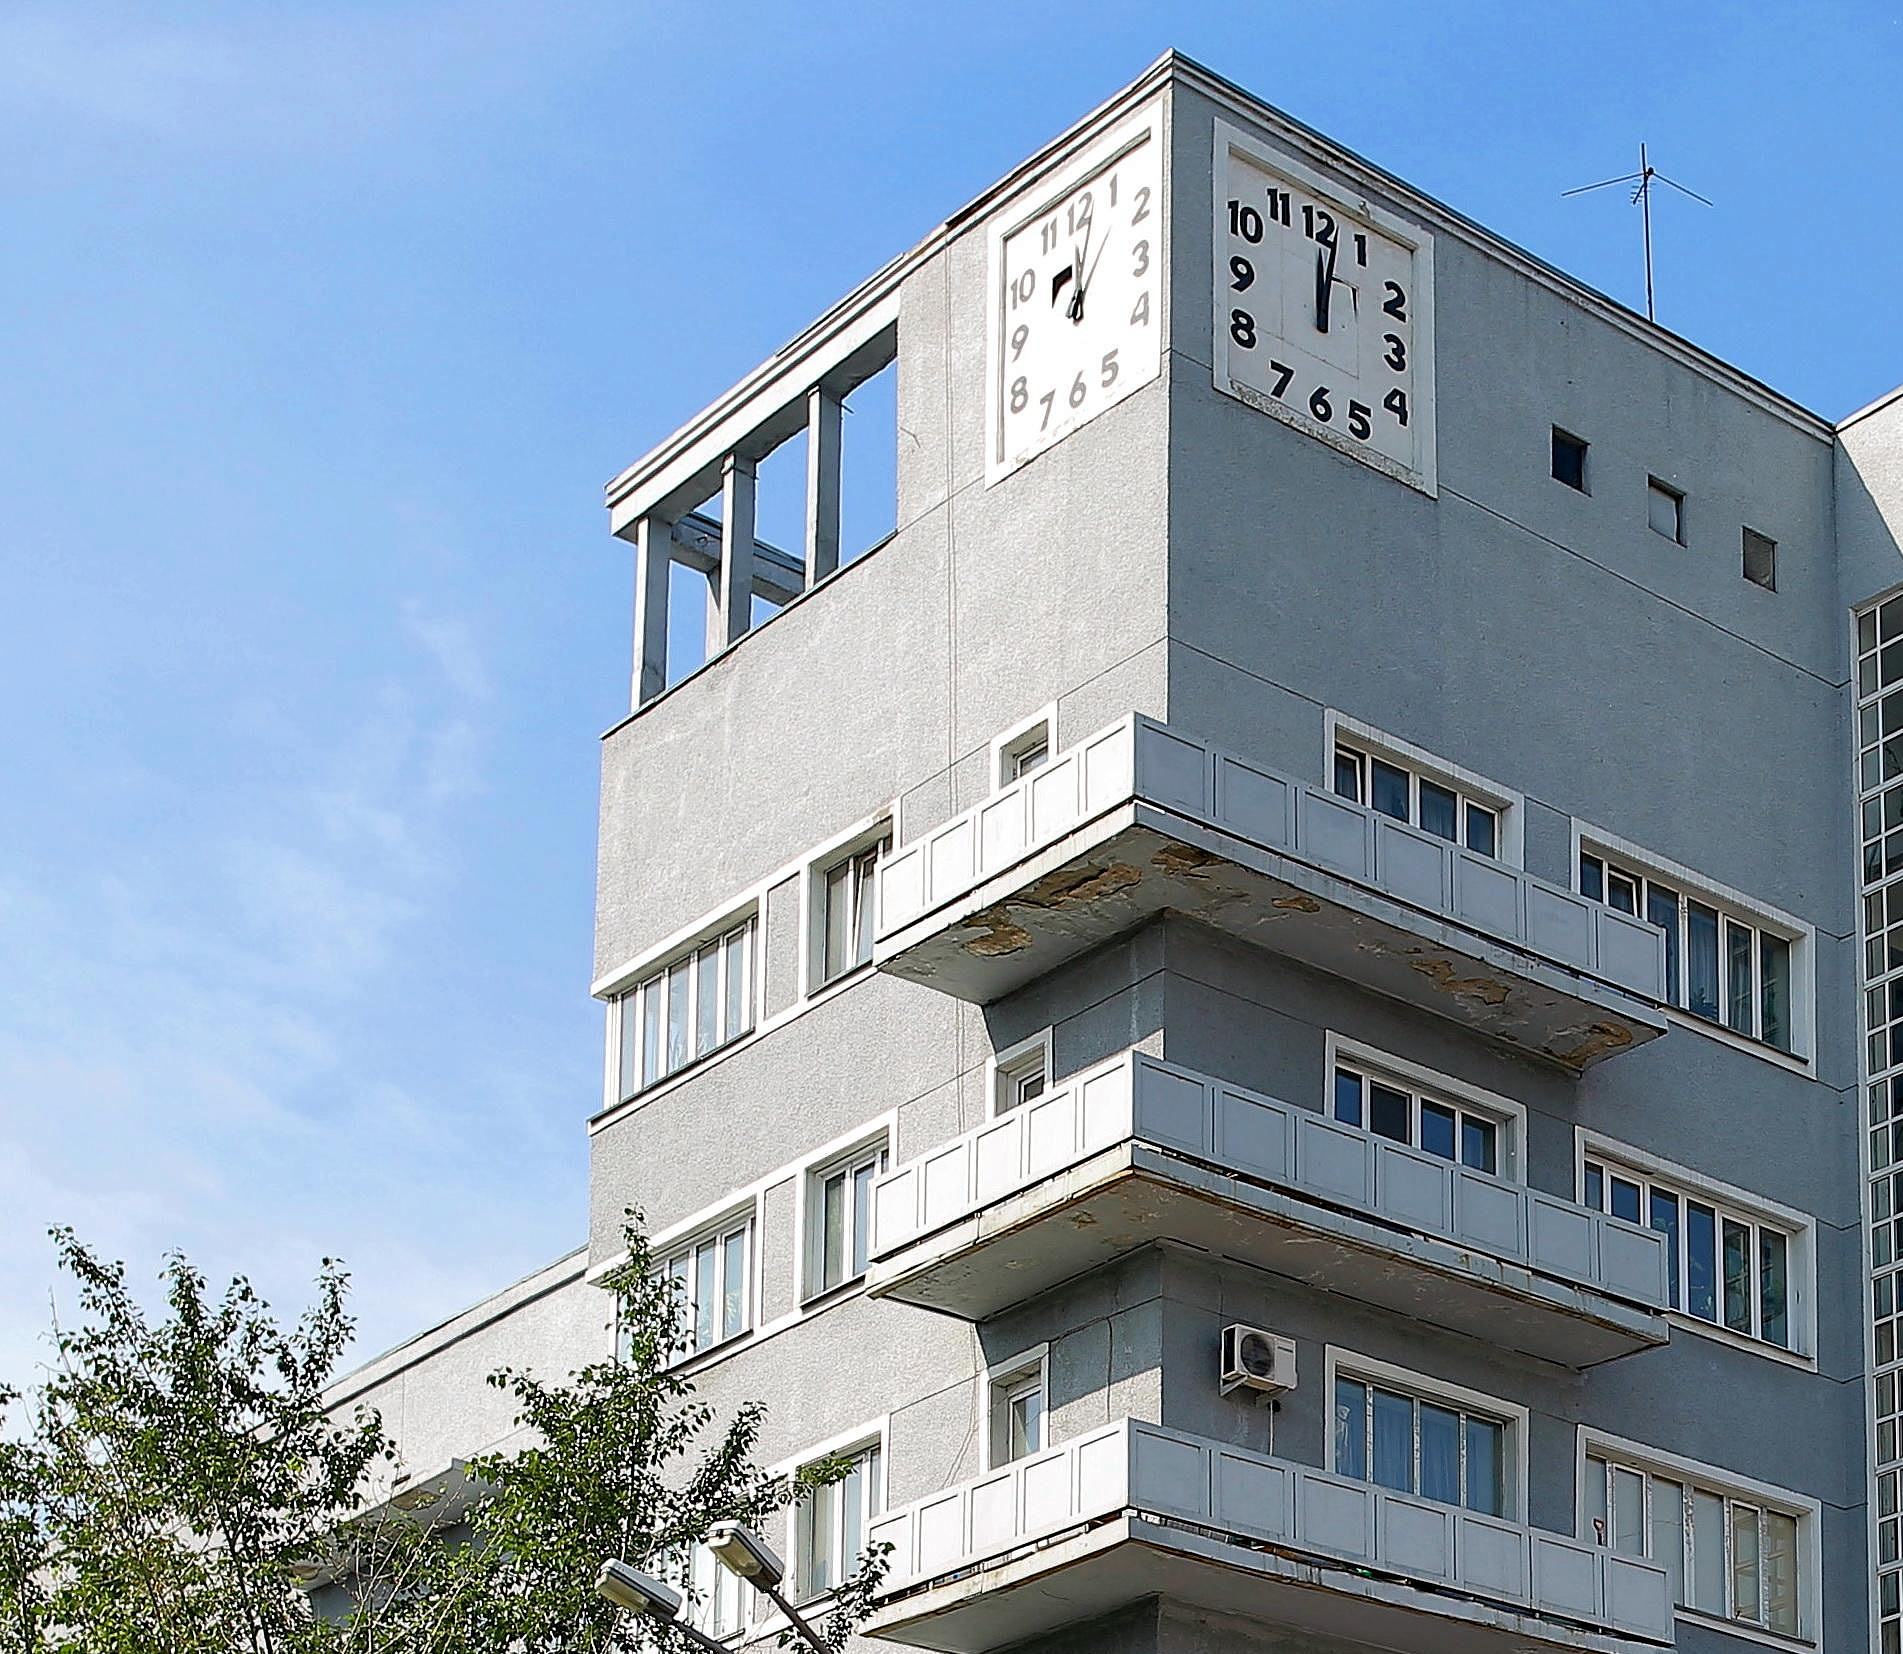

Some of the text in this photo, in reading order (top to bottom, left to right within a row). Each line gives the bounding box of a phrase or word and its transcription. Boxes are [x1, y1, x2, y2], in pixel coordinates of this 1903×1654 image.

[1110, 173, 1118, 208] 1
[1132, 186, 1150, 227] 2
[1267, 188, 1291, 227] 11
[1067, 191, 1092, 236] 12
[1228, 200, 1263, 243] 10
[1302, 205, 1336, 249] 12
[1041, 216, 1057, 256] 11
[1354, 234, 1367, 267] 1
[1132, 240, 1150, 277] 3
[1230, 256, 1254, 292] 9
[1011, 268, 1036, 310] 10
[1130, 291, 1149, 326] 4
[1383, 281, 1406, 323] 2
[1011, 324, 1029, 363] 9
[1230, 309, 1257, 349] 8
[1102, 348, 1119, 388] 5
[1384, 334, 1406, 372] 3
[1011, 376, 1029, 414] 8
[1069, 370, 1086, 409] 6
[1270, 360, 1294, 398] 7
[1040, 389, 1055, 432] 7
[1309, 386, 1332, 422] 6
[1348, 400, 1372, 440] 5
[1384, 388, 1408, 427] 4
